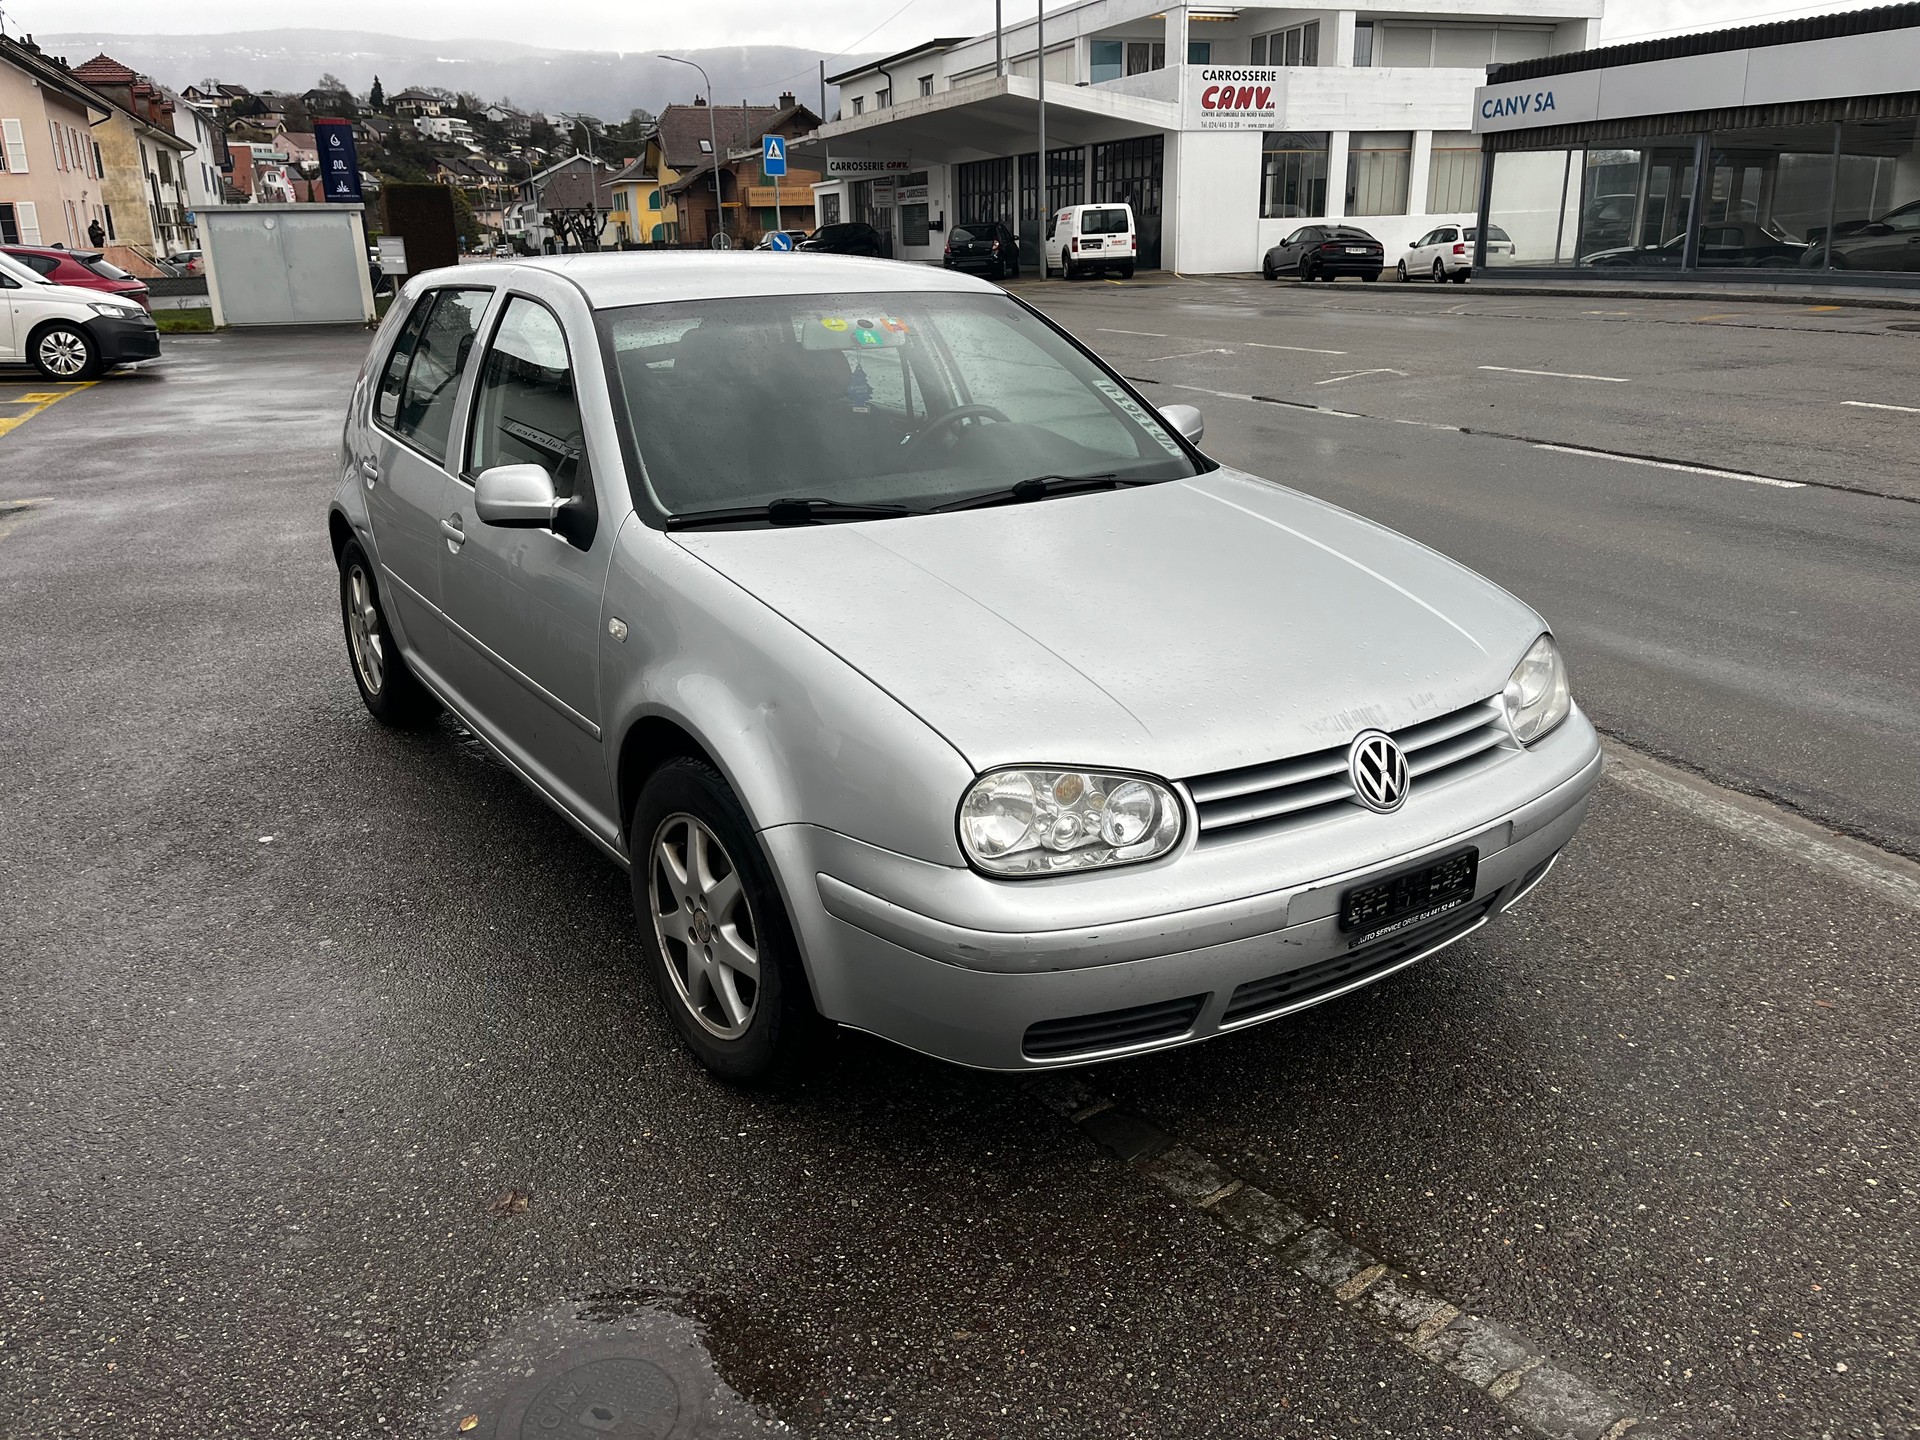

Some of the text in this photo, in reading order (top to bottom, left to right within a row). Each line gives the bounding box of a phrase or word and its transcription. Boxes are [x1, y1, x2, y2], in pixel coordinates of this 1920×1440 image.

[1202, 70, 1276, 81] CARROSSERIE
[1202, 86, 1271, 109] CANV
[1482, 91, 1555, 119] CANV SA
[830, 161, 884, 171] CARROSSERIE
[1358, 932, 1375, 944] AUTO
[1375, 921, 1402, 937] SERVICE
